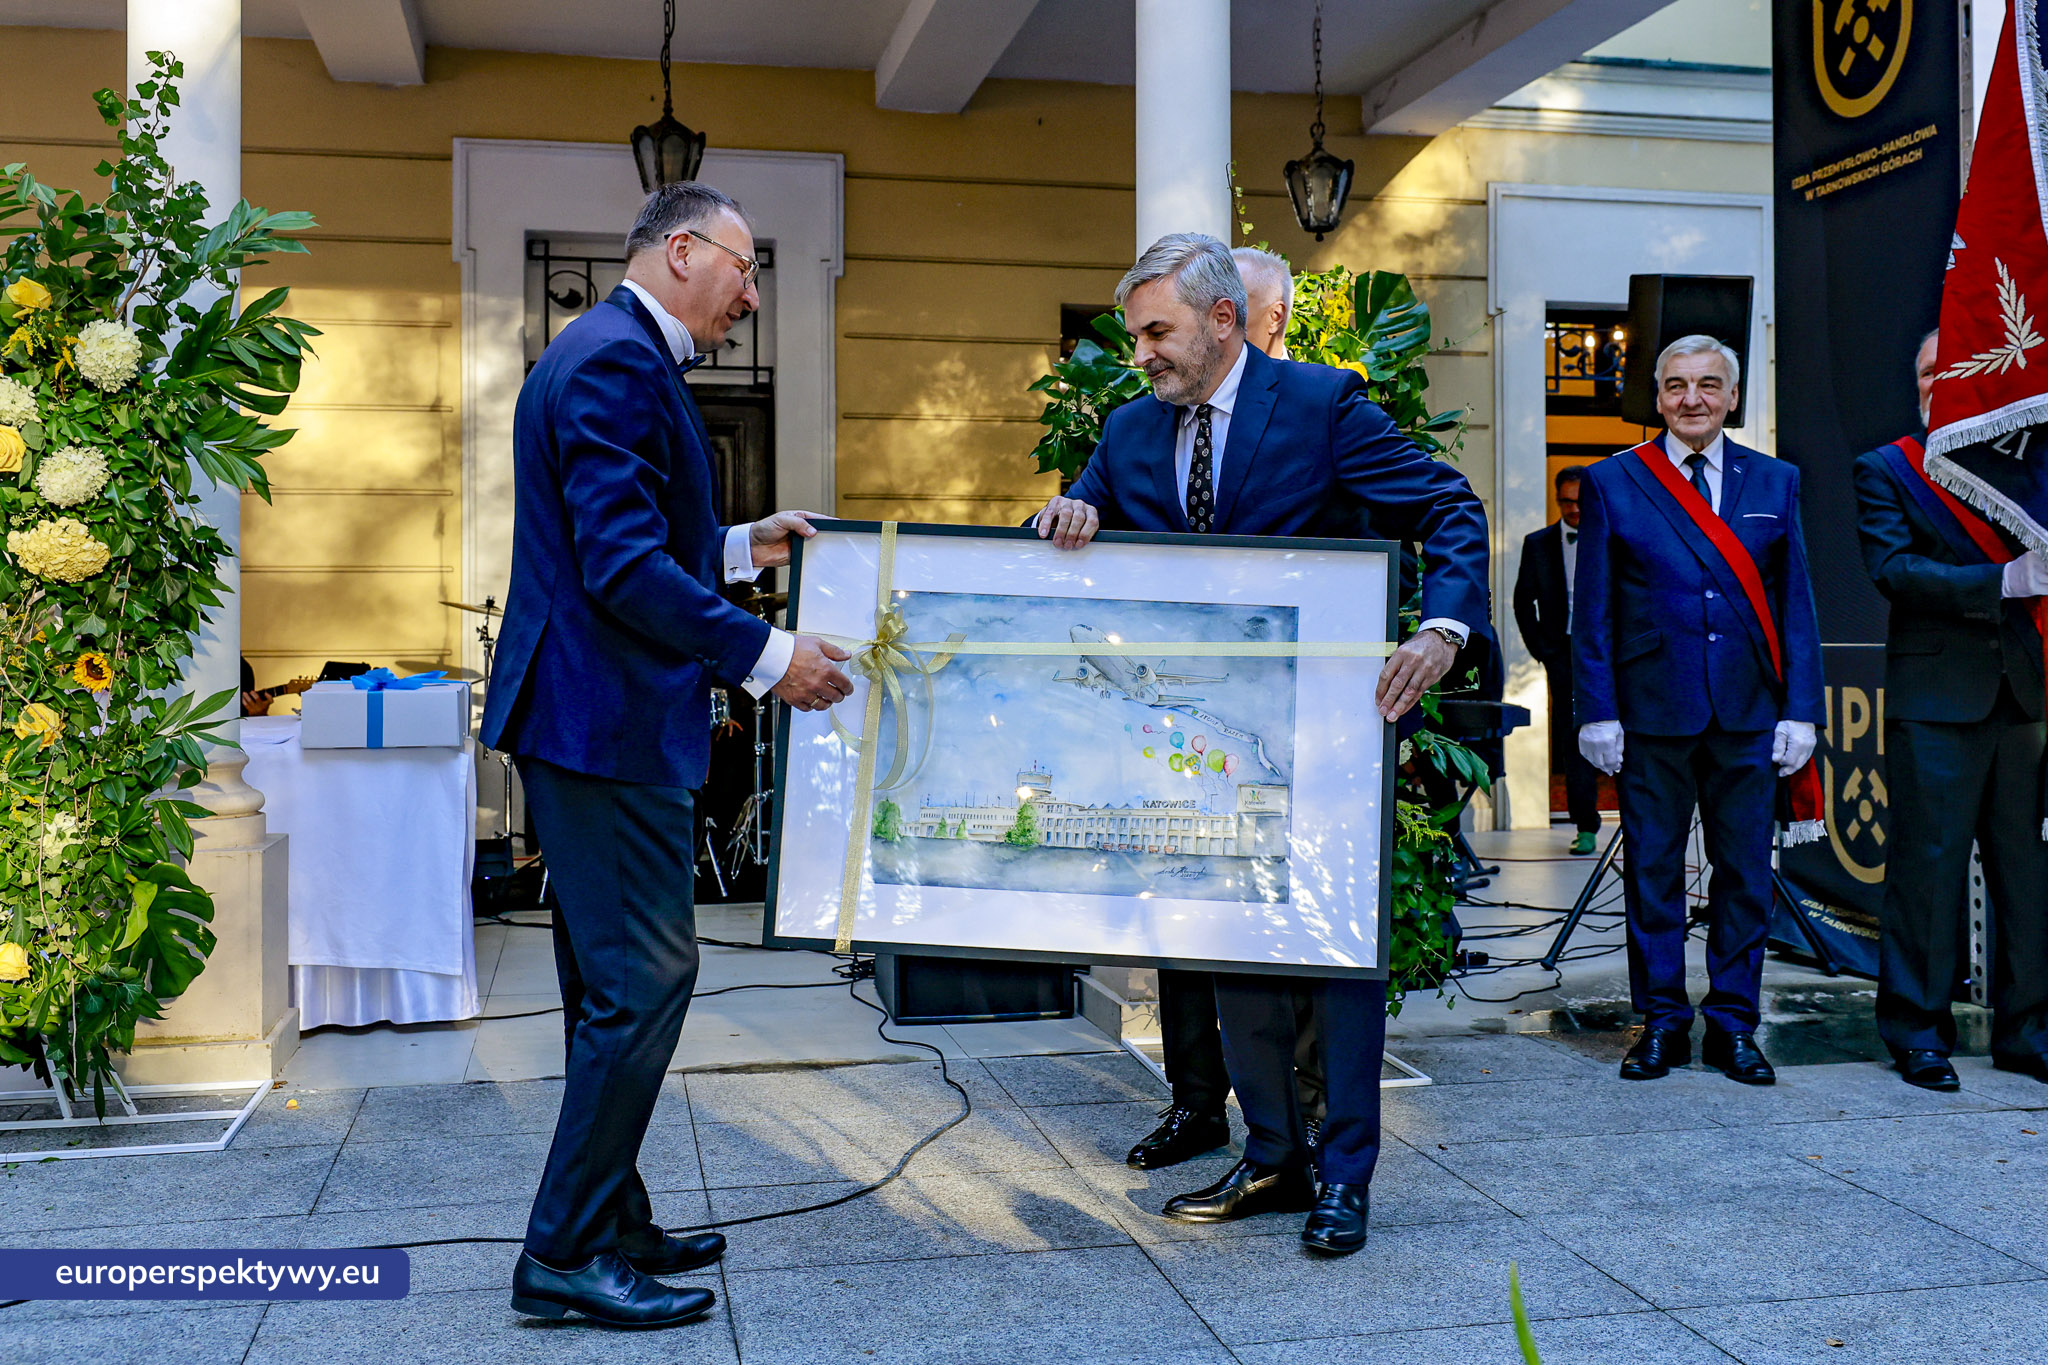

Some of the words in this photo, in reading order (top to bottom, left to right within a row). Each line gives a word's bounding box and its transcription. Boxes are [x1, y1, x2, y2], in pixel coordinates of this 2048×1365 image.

[1805, 189, 1815, 201] W
[1815, 165, 1880, 197] TARNOWSKICH
[1881, 148, 1923, 173] GÓRACH
[1792, 174, 1811, 190] IZBA
[1142, 800, 1197, 809] KATOWICE
[1800, 899, 1825, 911] IZBA
[1808, 910, 1821, 918] W
